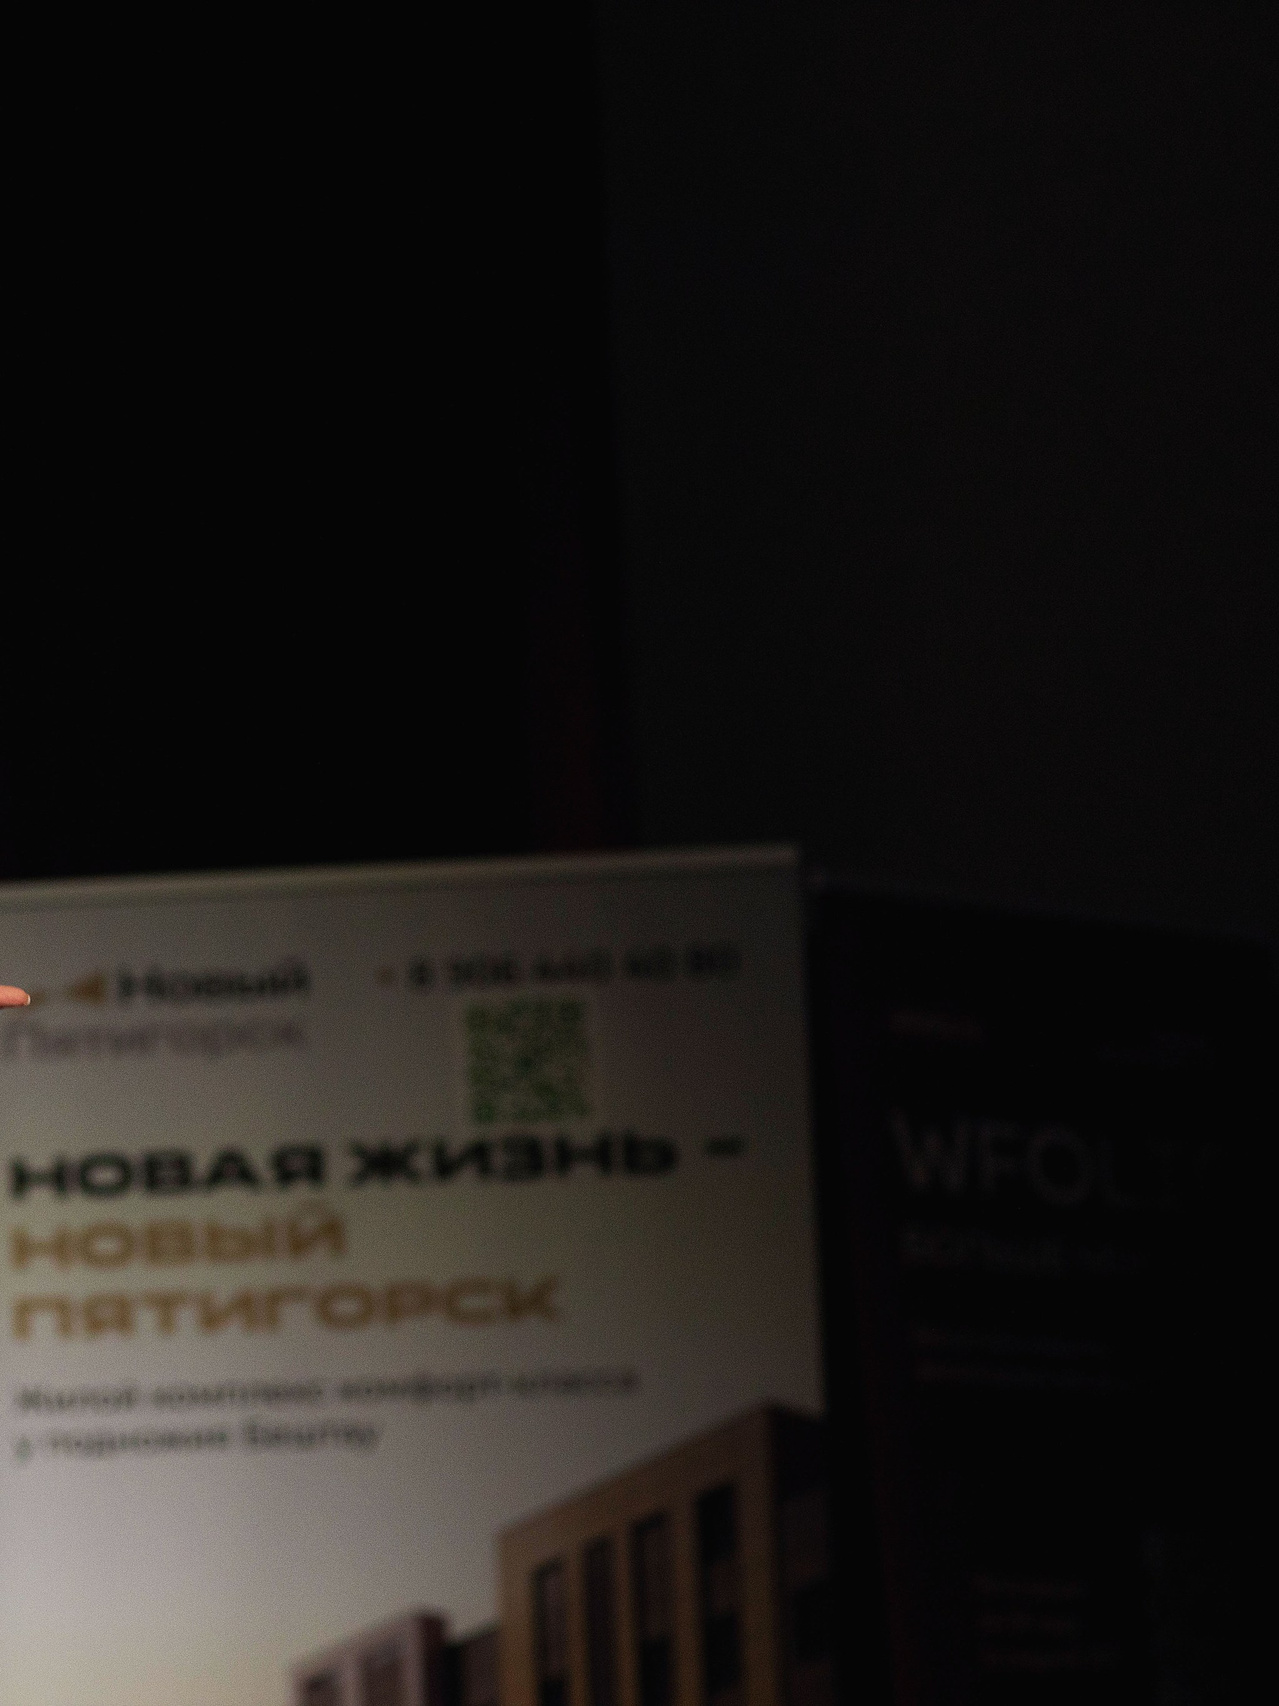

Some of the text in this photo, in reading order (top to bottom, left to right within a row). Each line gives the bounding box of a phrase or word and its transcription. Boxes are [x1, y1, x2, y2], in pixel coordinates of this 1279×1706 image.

[117, 957, 311, 1007] Новый
[407, 955, 433, 993] 8
[2, 1018, 307, 1064] Пятигорск
[10, 1143, 325, 1199] НОВАЯ
[347, 1131, 680, 1187] ЖИЗНЬ
[10, 1203, 348, 1271] НОВЫЙ
[11, 1275, 562, 1342] ПЯТИГОРСК
[17, 1380, 139, 1415] Жилой
[150, 1376, 328, 1410] комплекс
